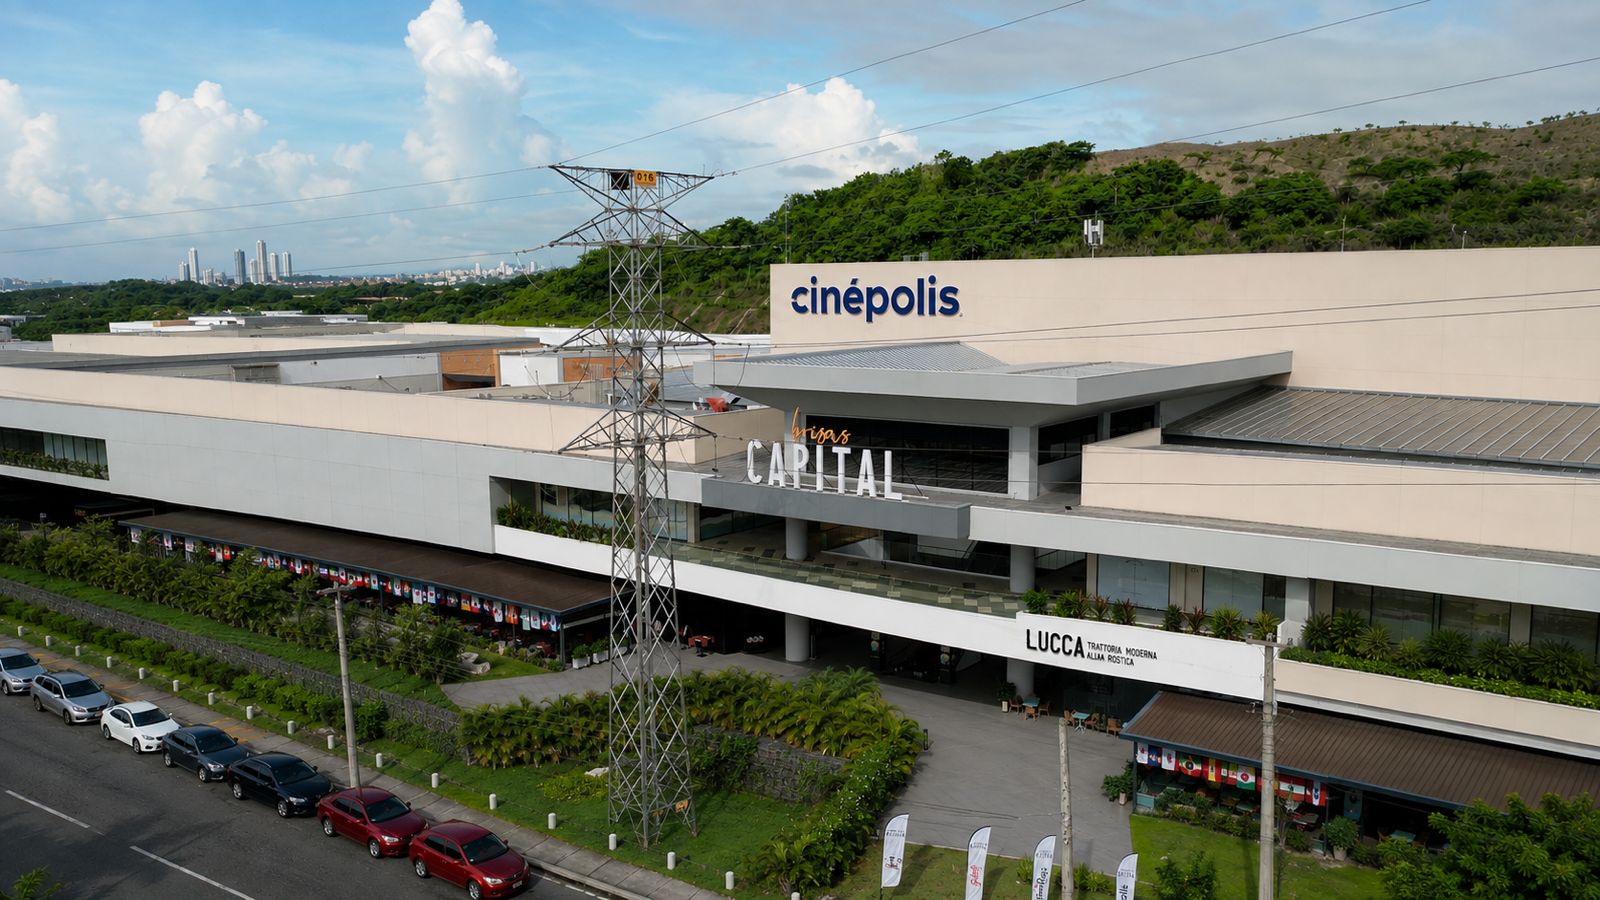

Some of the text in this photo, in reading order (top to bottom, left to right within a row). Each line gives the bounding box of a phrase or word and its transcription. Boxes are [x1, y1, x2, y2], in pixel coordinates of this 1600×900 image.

[637, 172, 654, 182] 016
[791, 275, 960, 322] cinépolis
[747, 439, 903, 501] CAPITAL
[1026, 629, 1085, 658] LUCCA
[1087, 641, 1157, 660] TRATTORIA MODERNA
